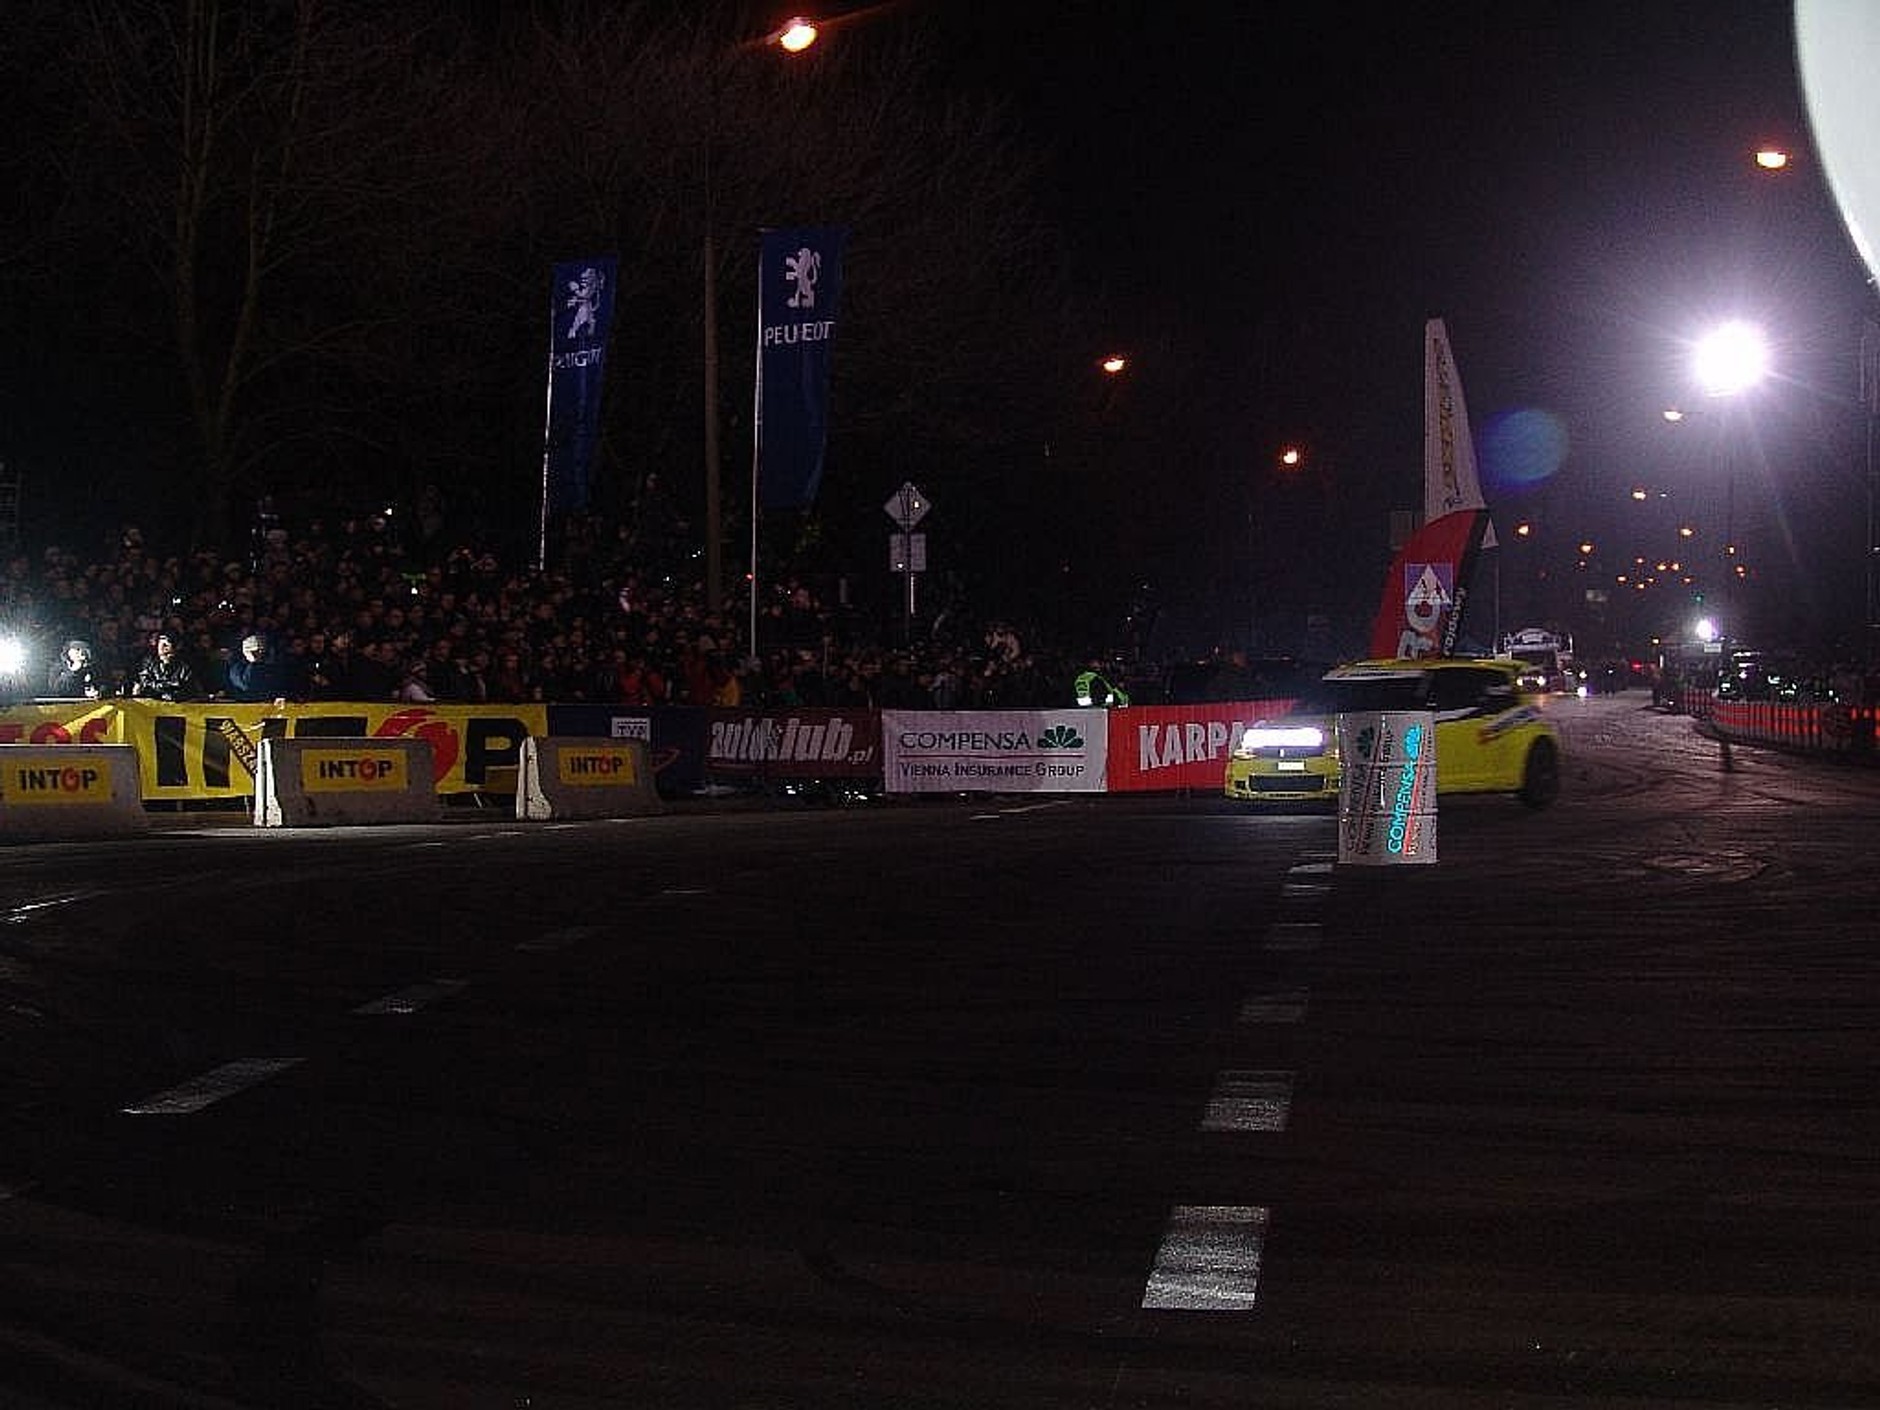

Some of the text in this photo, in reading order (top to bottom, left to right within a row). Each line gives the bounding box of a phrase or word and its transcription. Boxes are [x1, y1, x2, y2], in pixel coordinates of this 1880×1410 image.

[763, 320, 837, 347] PEUEOT
[901, 731, 1031, 751] COMPENSA
[319, 757, 392, 782] INTOP
[569, 752, 623, 776] INTOP
[901, 762, 1085, 778] VIENNA INSURANCE GROUP
[19, 765, 97, 791] INTOP
[1386, 759, 1418, 854] COMPENSA
